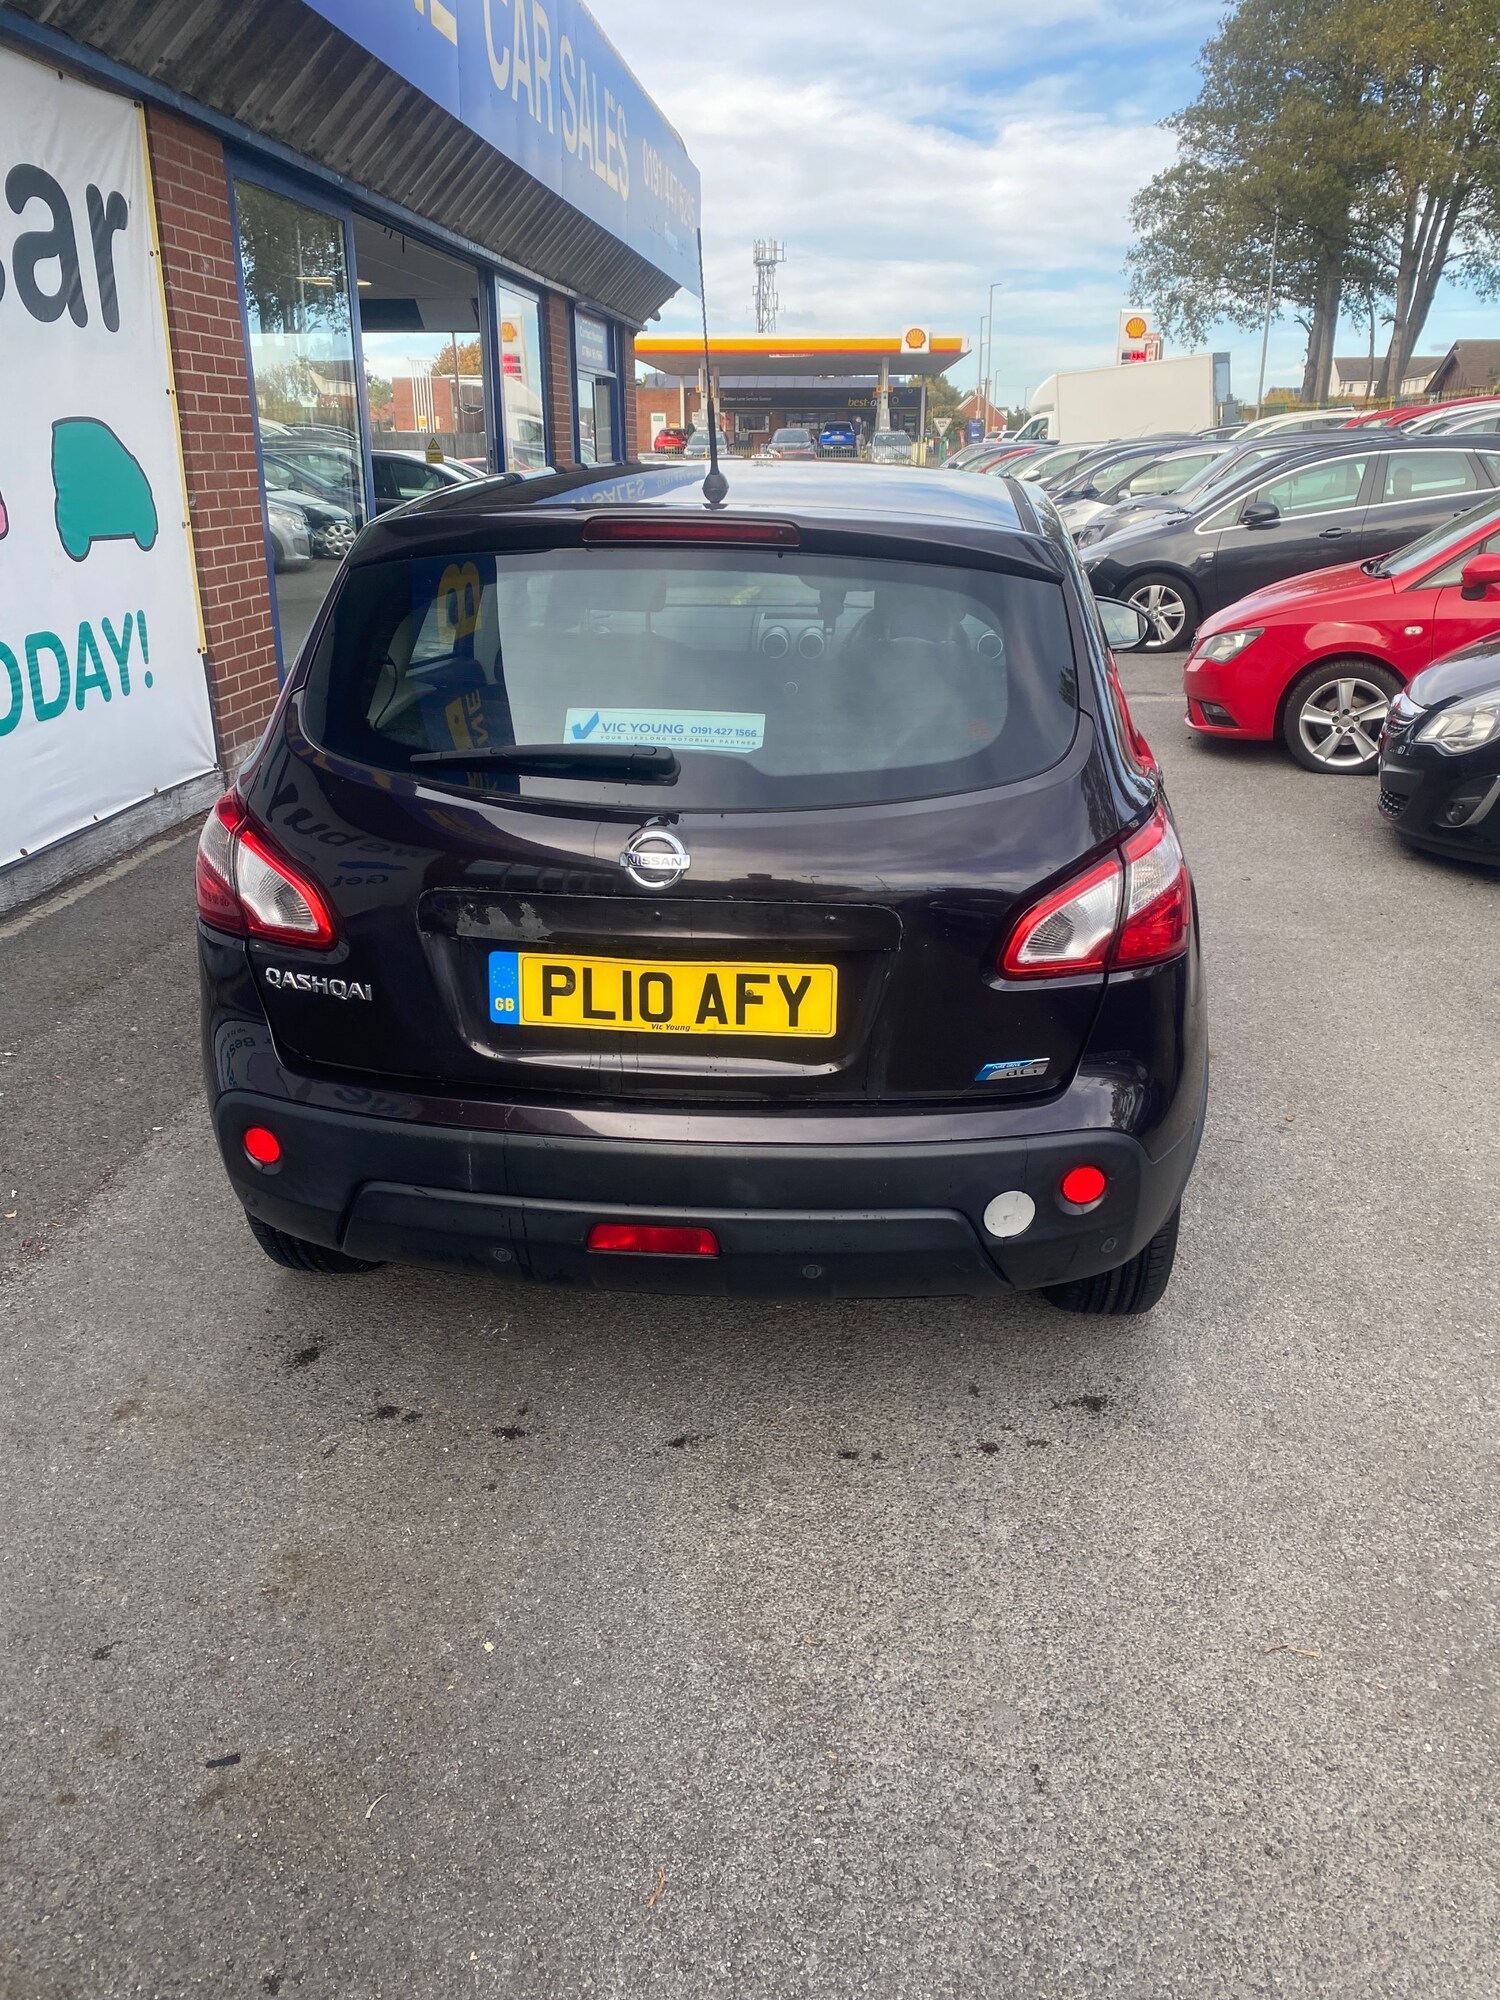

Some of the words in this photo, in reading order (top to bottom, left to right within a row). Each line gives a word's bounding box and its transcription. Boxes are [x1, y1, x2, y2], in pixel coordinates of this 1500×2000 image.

[483, 0, 554, 135] CAR
[560, 34, 630, 202] SALES
[0, 163, 128, 332] ar
[601, 722, 627, 733] VIC
[629, 723, 684, 735] YOUNG
[690, 725, 713, 736] 0191
[714, 727, 733, 736] 427
[735, 728, 757, 738] 1566
[626, 852, 683, 867] NISSAN
[264, 967, 373, 1001] QASHQAI
[541, 964, 674, 1024] PL10
[695, 973, 812, 1028] AFY
[494, 996, 515, 1012] GB
[651, 1022, 664, 1032] Vic
[665, 1023, 691, 1033] Young
